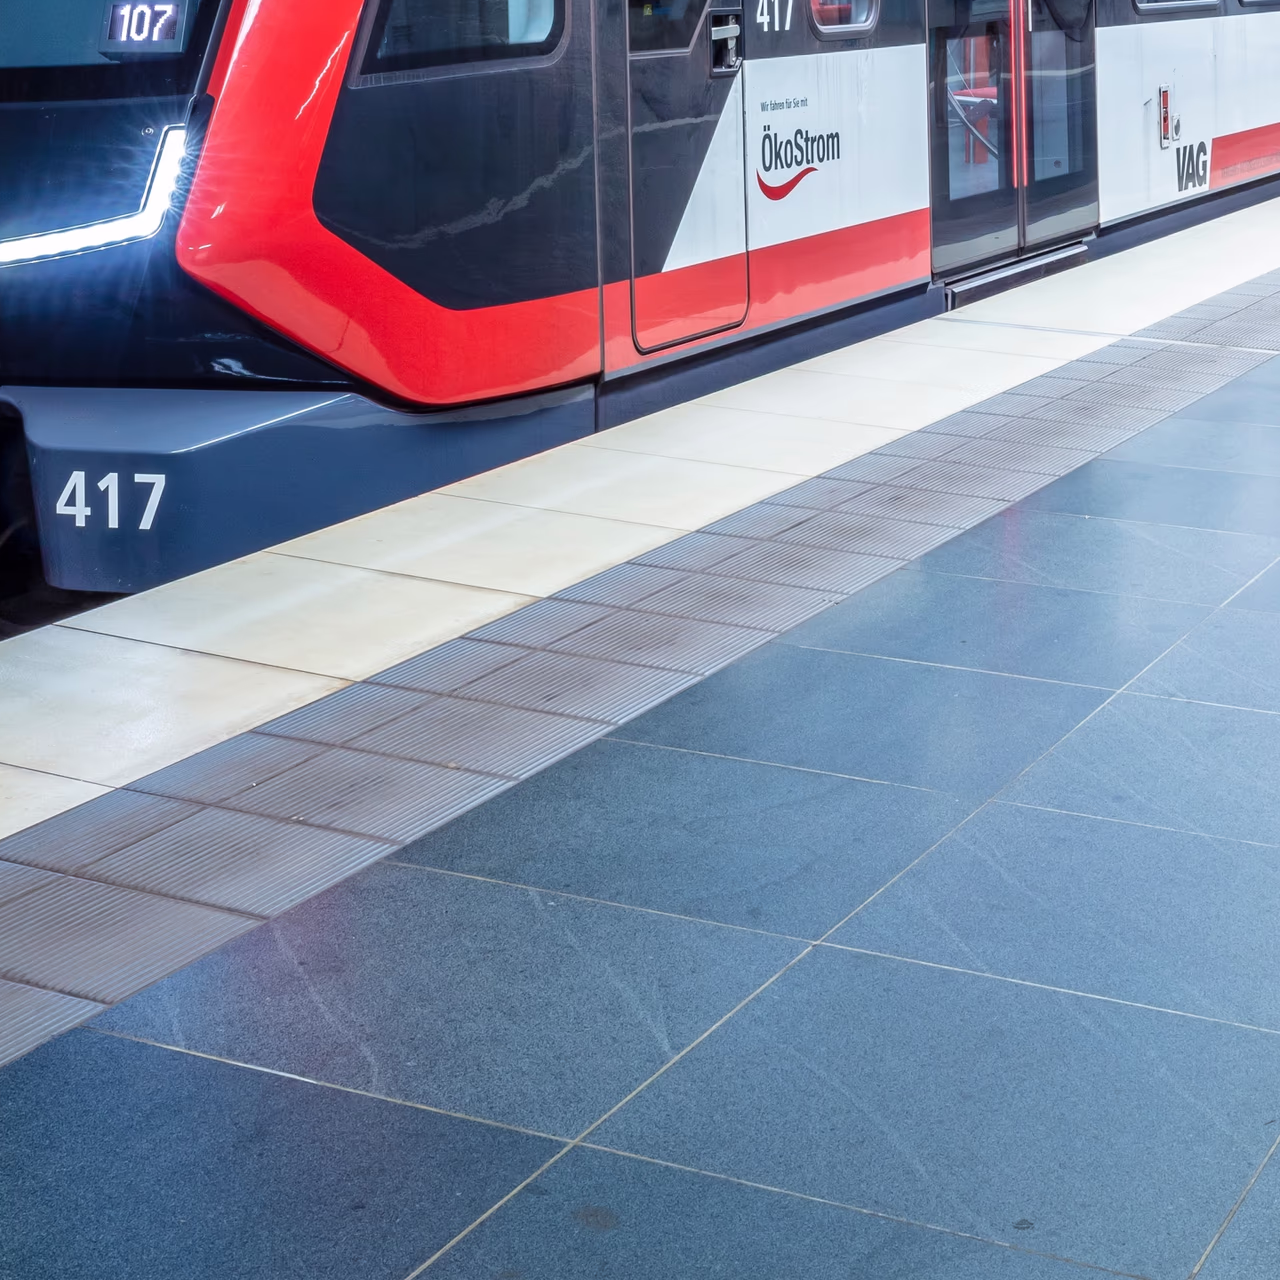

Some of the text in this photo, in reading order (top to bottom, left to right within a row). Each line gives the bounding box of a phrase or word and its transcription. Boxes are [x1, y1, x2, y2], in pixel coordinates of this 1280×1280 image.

[116, 3, 174, 44] 107
[760, 101, 770, 112] Wir
[770, 99, 785, 112] fahren
[785, 98, 793, 110] für
[800, 96, 808, 107] mit
[761, 124, 840, 173] ÖkoStrom
[1176, 141, 1208, 192] VAG
[56, 470, 166, 531] 417
